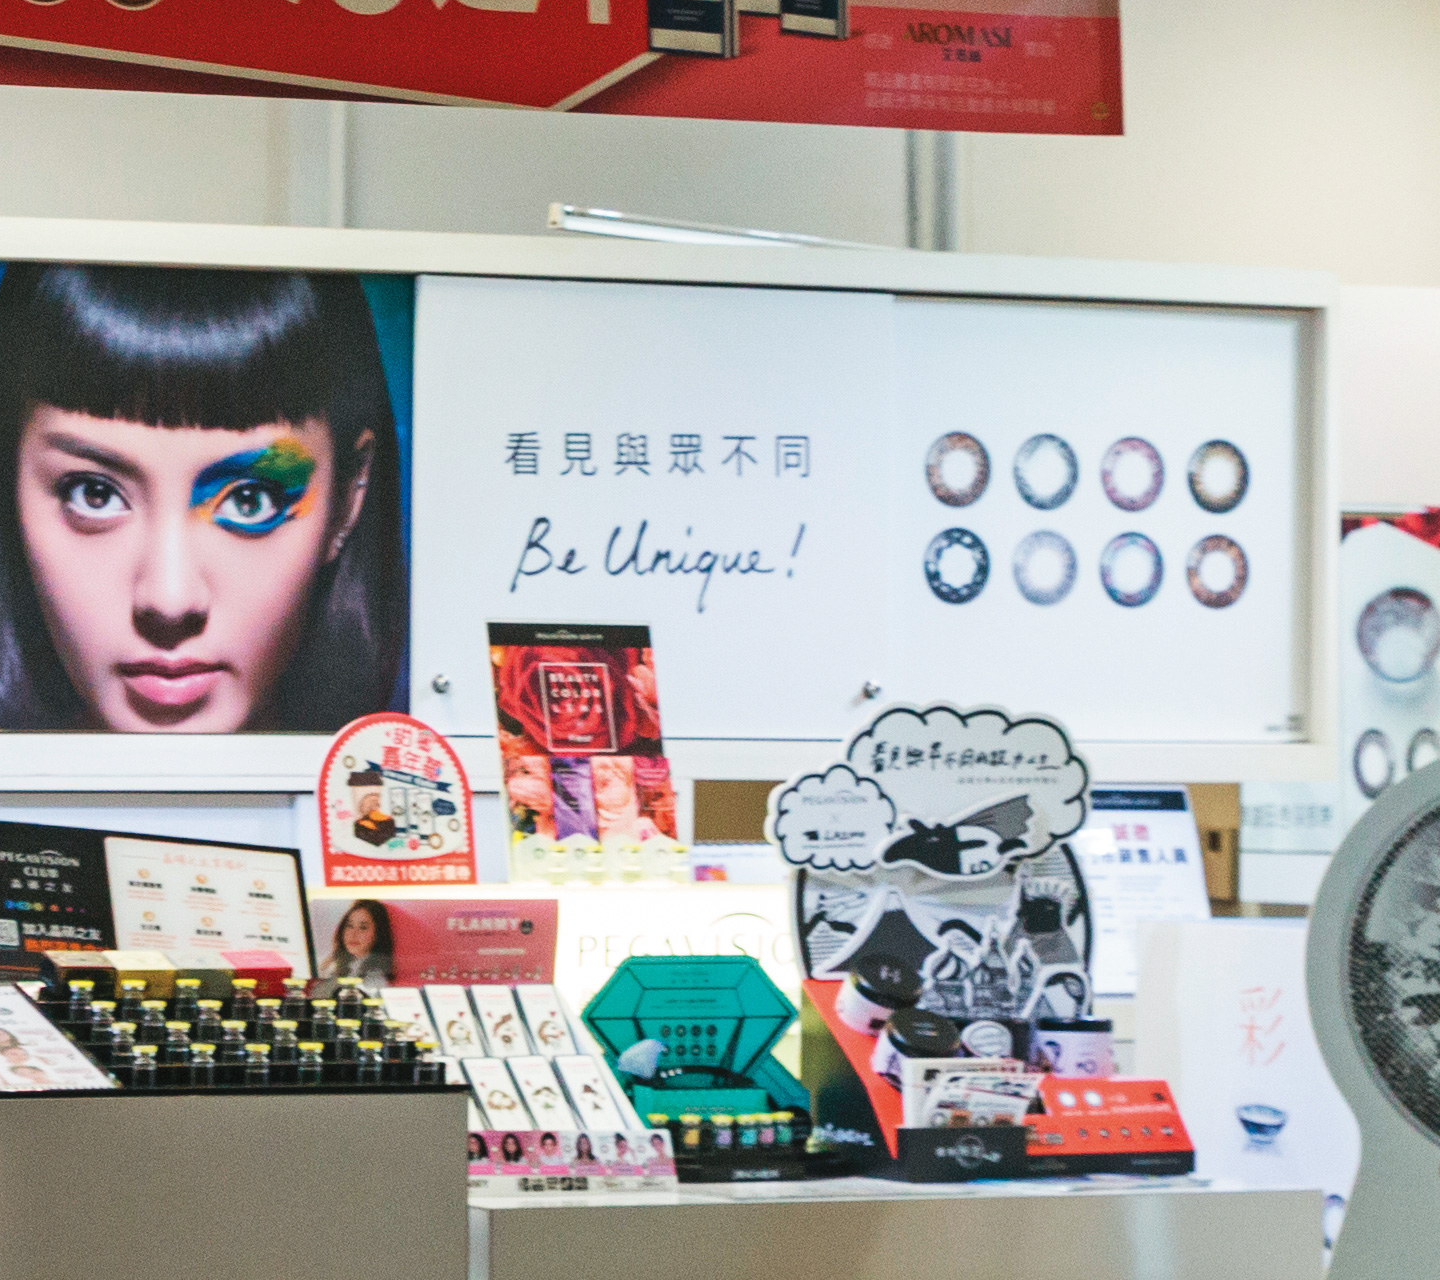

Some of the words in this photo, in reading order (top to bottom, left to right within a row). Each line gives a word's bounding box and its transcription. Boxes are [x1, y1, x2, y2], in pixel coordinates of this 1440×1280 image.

[504, 431, 813, 479] 看見與眾不同
[510, 516, 587, 594] Be
[604, 522, 807, 614] Unique!
